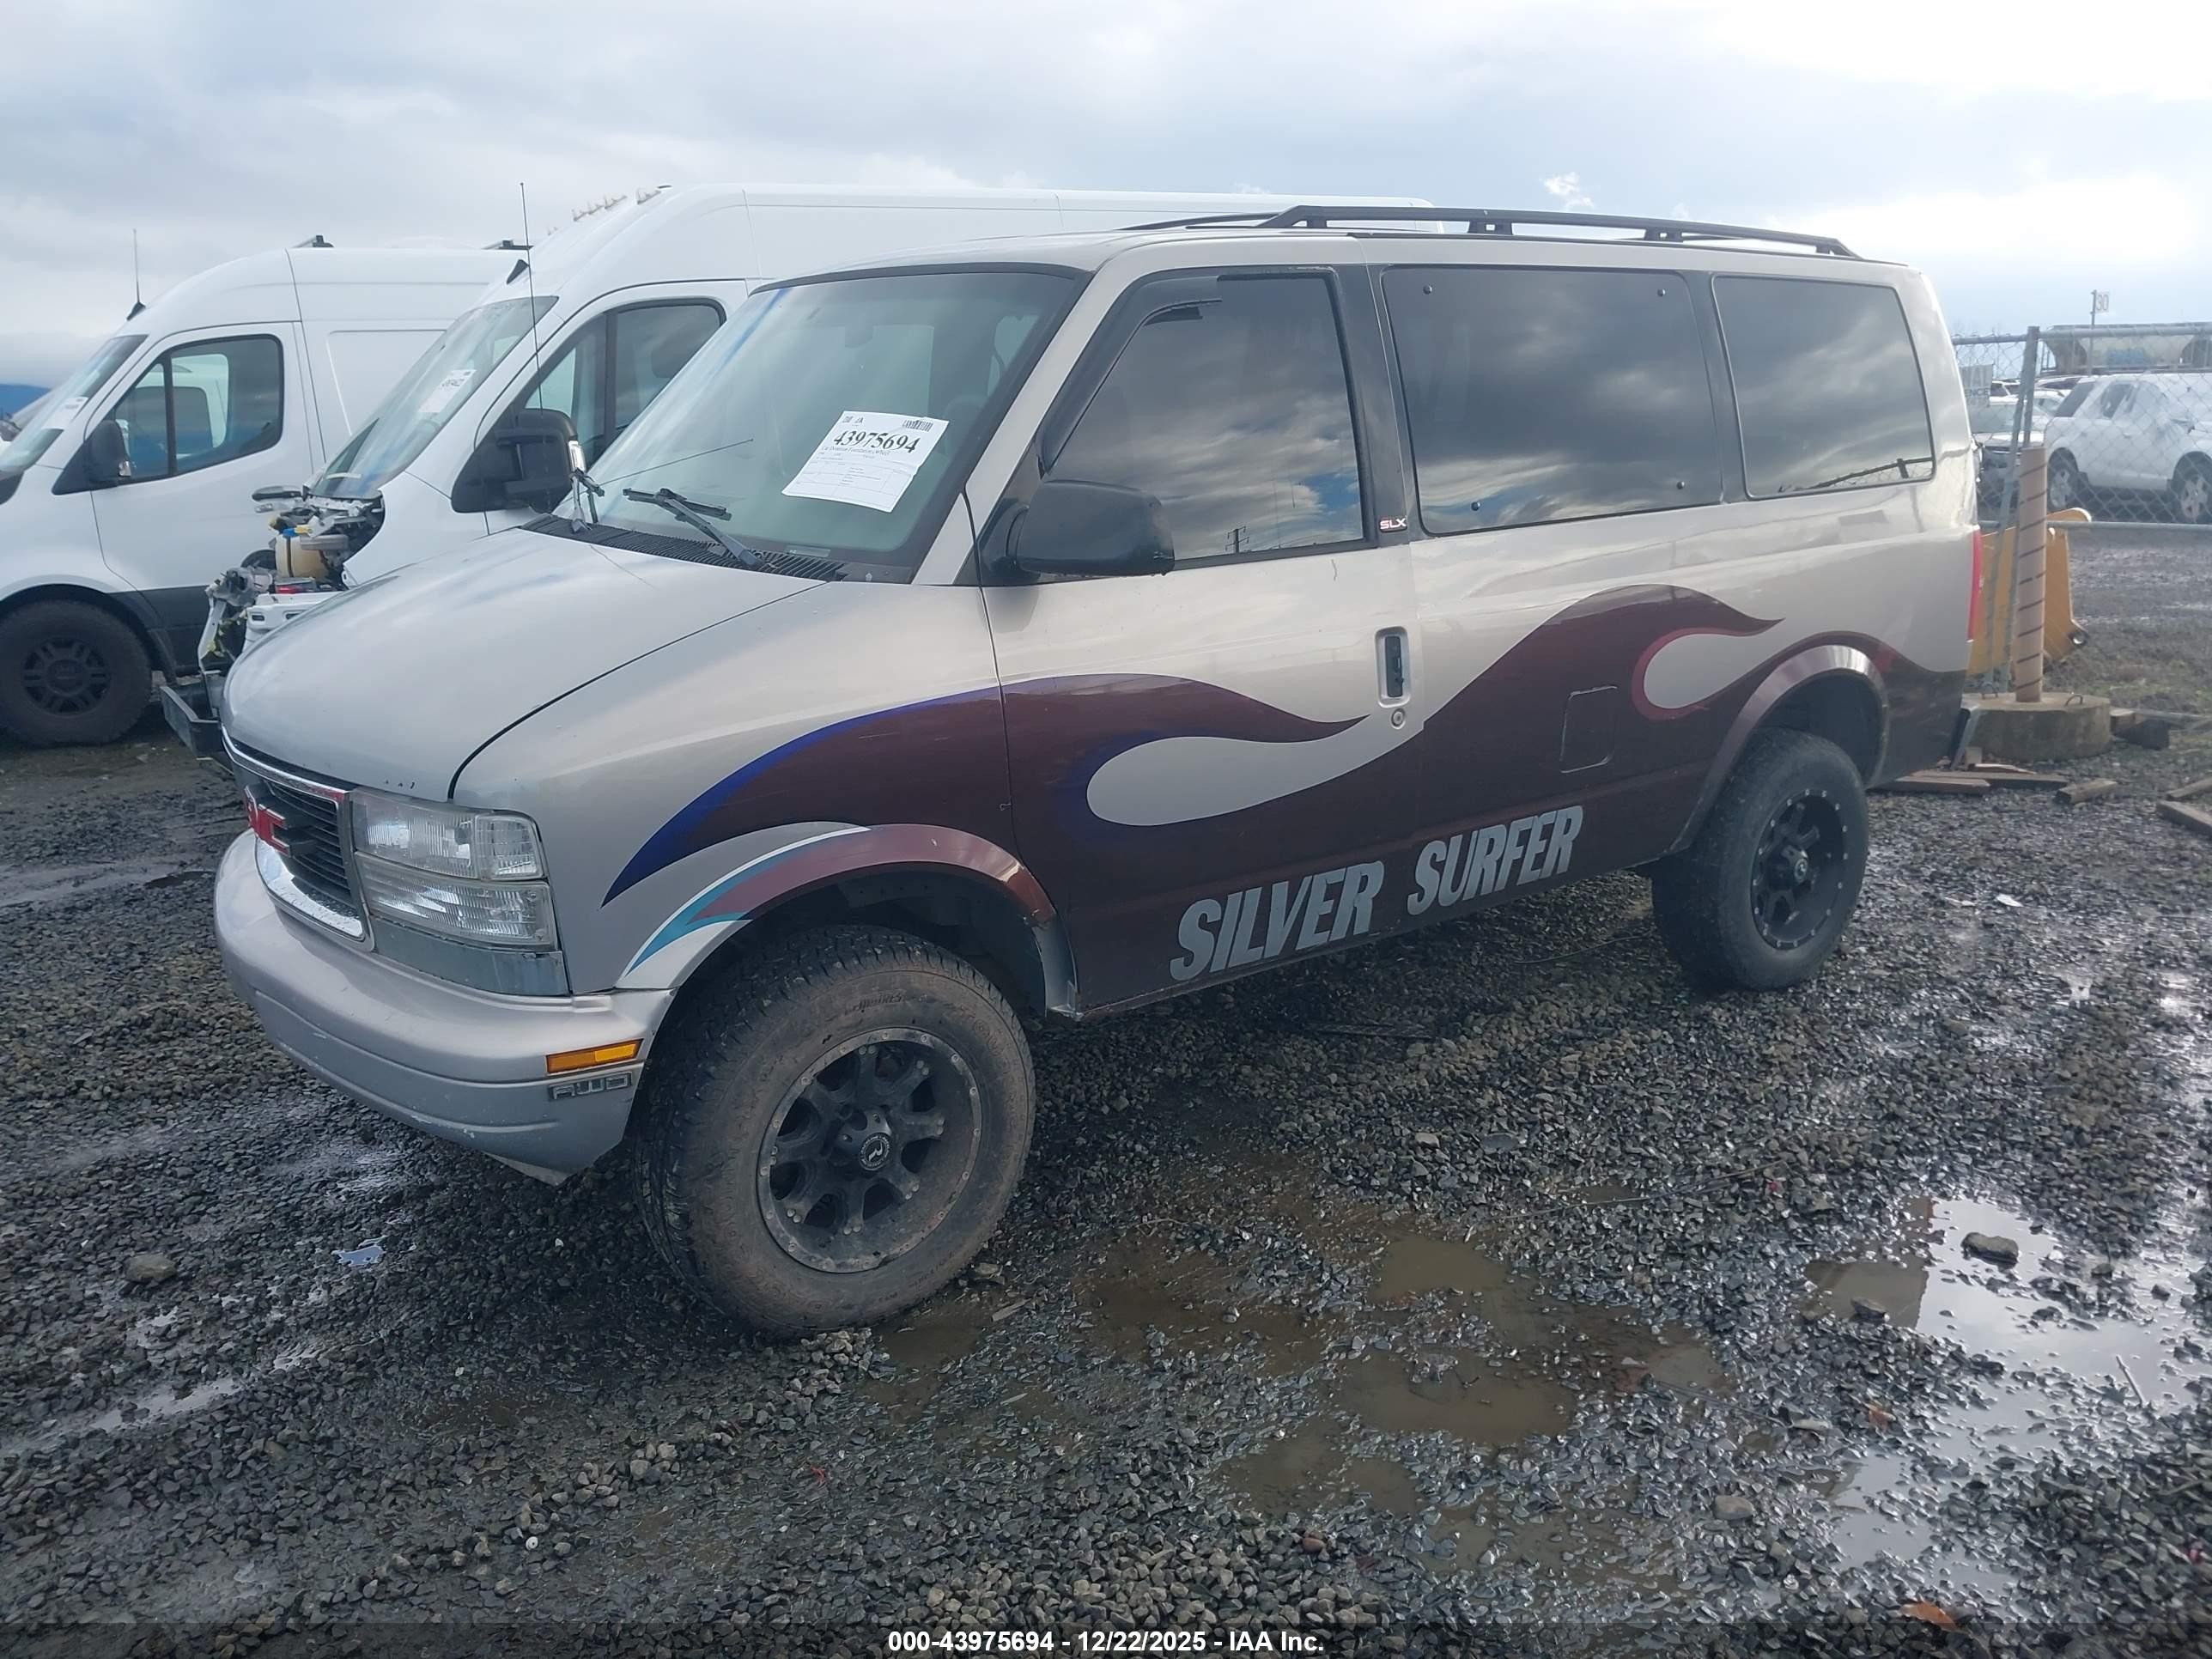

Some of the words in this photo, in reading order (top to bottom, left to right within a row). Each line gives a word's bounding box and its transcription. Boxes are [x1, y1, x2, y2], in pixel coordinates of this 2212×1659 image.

[833, 430, 921, 453] 43975694
[1379, 518, 1407, 530] SLX
[1170, 860, 1385, 981] SILVER
[1407, 805, 1584, 916] SURFER
